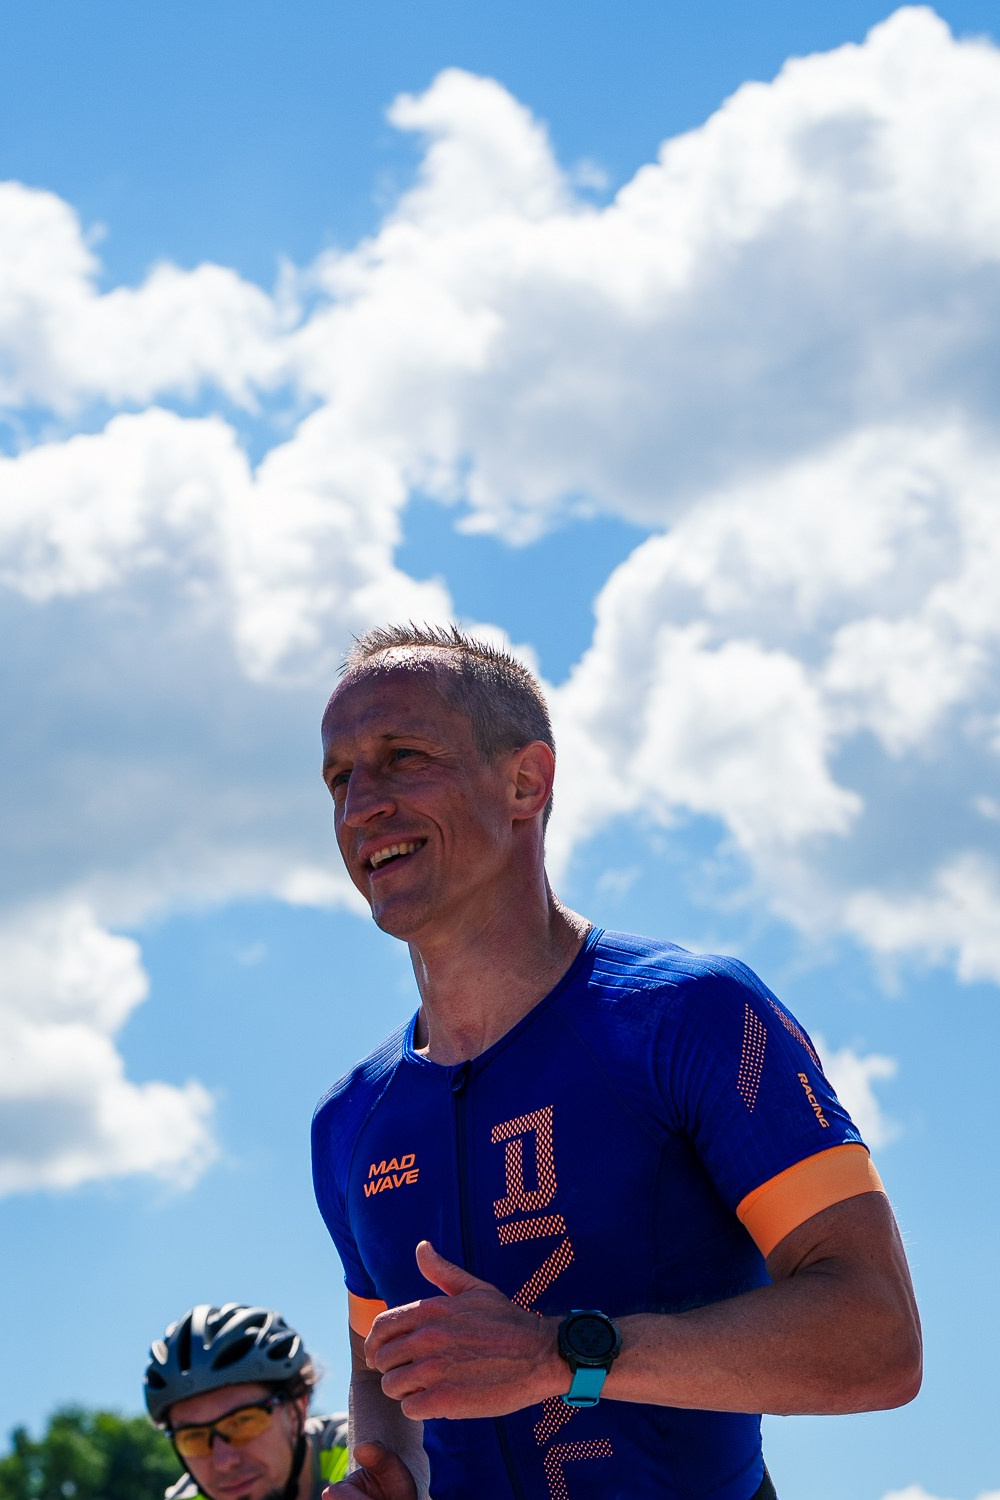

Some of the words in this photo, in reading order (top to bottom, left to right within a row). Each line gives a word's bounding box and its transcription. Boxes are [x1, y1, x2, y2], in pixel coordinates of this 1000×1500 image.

[797, 1072, 830, 1128] RACING
[368, 1153, 416, 1178] MAD
[363, 1168, 419, 1197] WAVE
